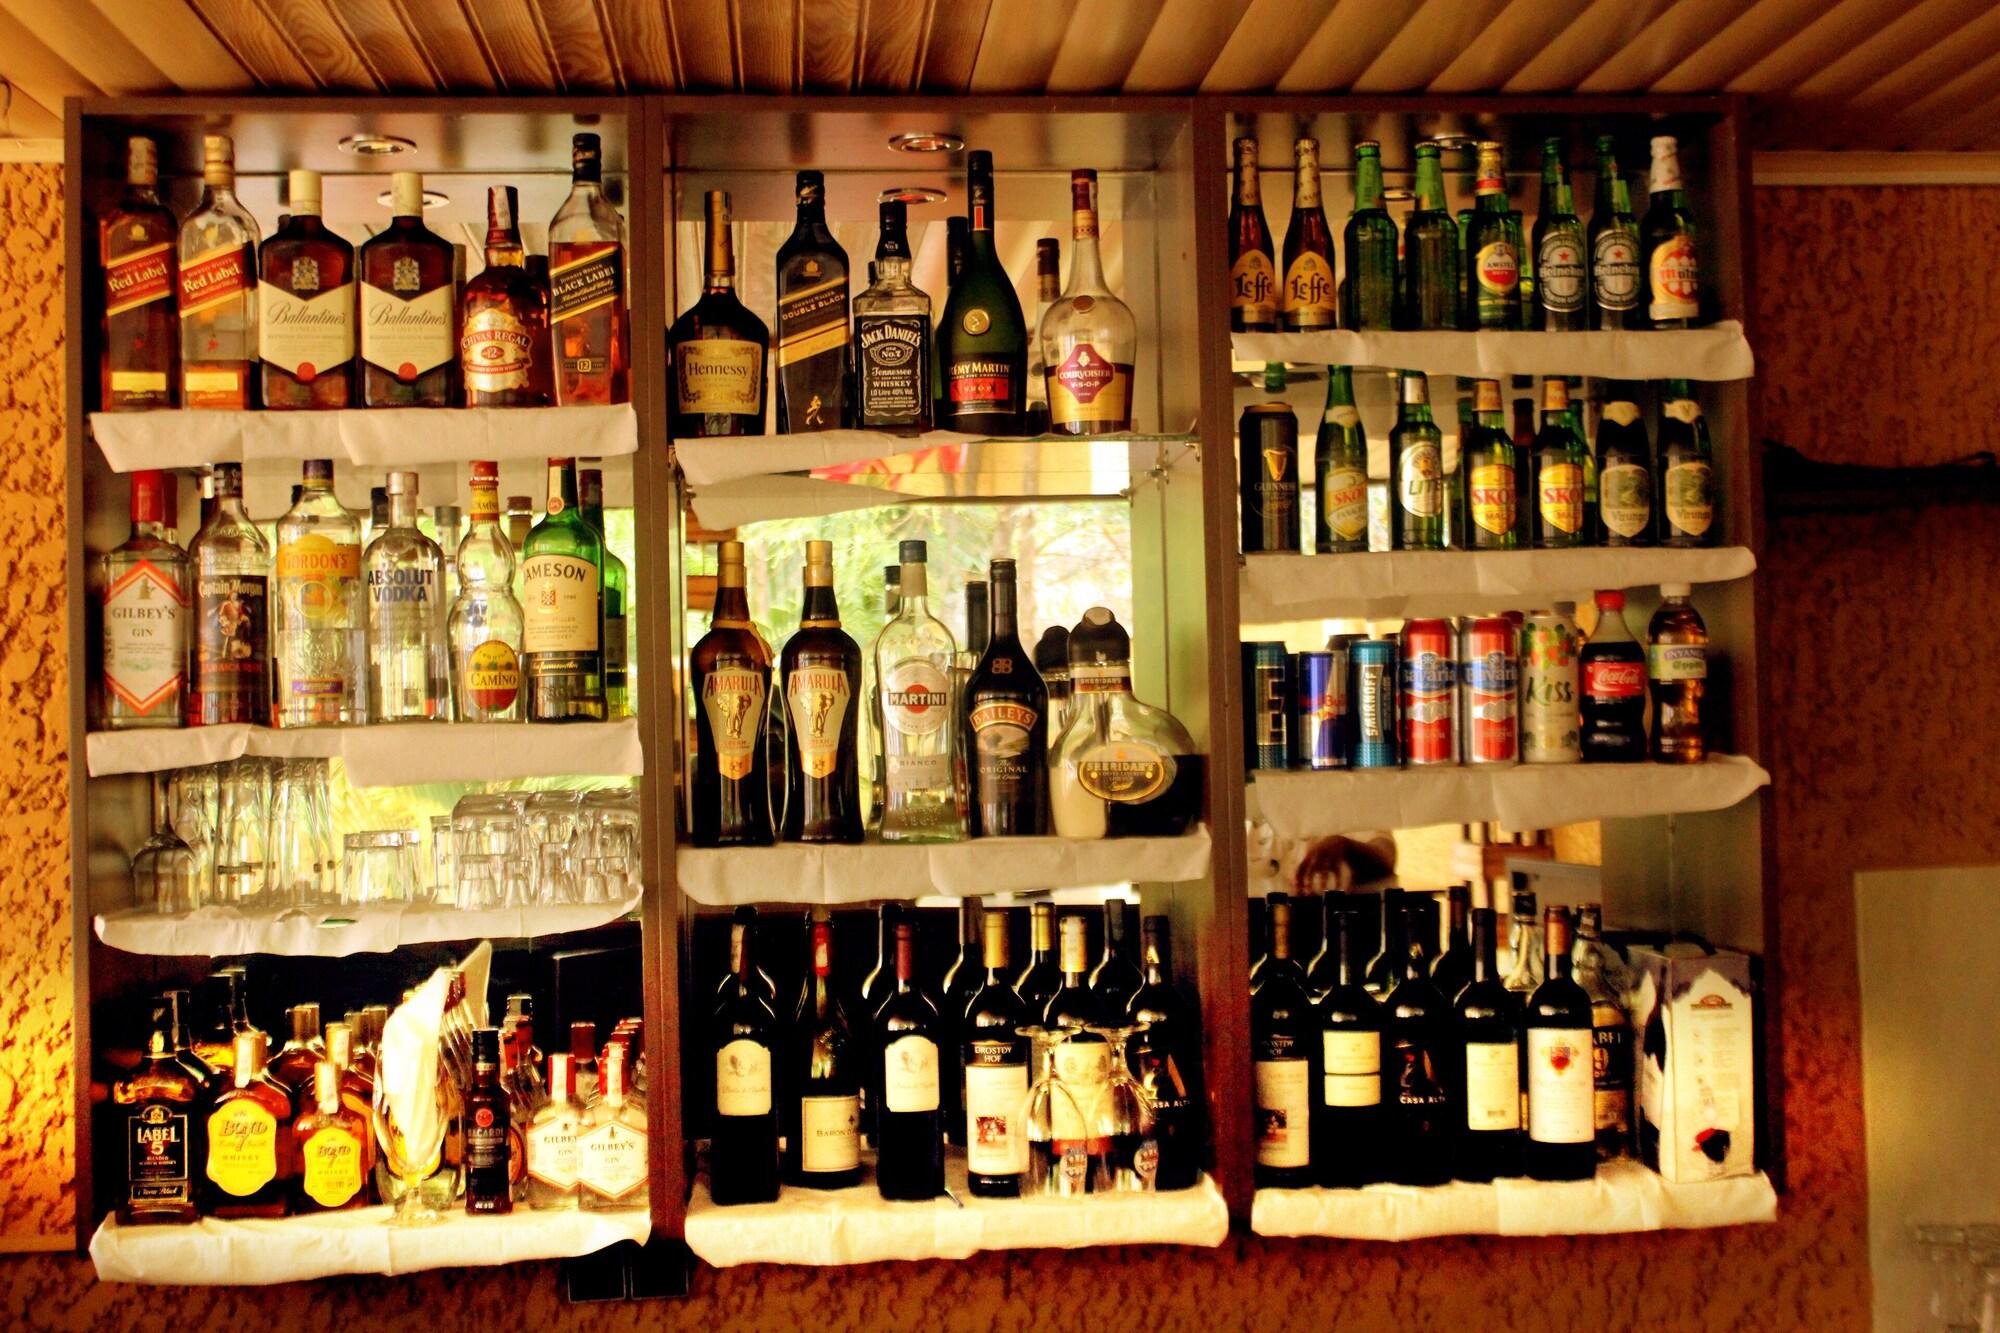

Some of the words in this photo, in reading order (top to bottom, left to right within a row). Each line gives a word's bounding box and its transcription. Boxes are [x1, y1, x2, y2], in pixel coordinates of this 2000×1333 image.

[107, 273, 133, 293] Red
[134, 262, 169, 283] Label
[182, 273, 208, 294] Red
[207, 262, 241, 283] Label
[551, 279, 585, 297] BLACK
[585, 265, 616, 284] LABEL
[1234, 271, 1273, 303] Leffe
[1290, 272, 1330, 304] Leffe
[267, 302, 346, 325] Ballantine's
[368, 303, 448, 326] Ballantine's
[782, 303, 817, 320] DOUBLE
[818, 293, 845, 308] BLACK
[463, 329, 492, 349] CHIVAS
[494, 330, 529, 347] REGAL
[861, 328, 885, 348] JACK
[884, 324, 922, 347] DANIEL'S
[688, 362, 749, 380] Hennessy
[871, 367, 912, 376] Tennessee
[971, 361, 1010, 374] MARTIN
[367, 569, 433, 587] ABSOLUT
[199, 579, 230, 598] Captain
[230, 579, 263, 596] Morgan
[373, 586, 428, 602] VODKA
[112, 605, 176, 620] GILBEY'S
[131, 628, 153, 638] GIN
[471, 672, 517, 686] CAMINO
[707, 674, 764, 699] AMARULA
[789, 673, 847, 698] AMARULA
[889, 693, 946, 706] MARTINI
[1363, 672, 1379, 737] SMIRNOFF
[974, 707, 1033, 725] BAILEYS
[980, 765, 1027, 773] ORIGINAL
[974, 1046, 1012, 1054] DROSTDY
[984, 1055, 1002, 1063] HOF
[1399, 1095, 1425, 1104] CASA
[137, 1125, 180, 1143] LABEL
[151, 1141, 164, 1156] 5
[590, 1140, 635, 1152] GILBEY'S
